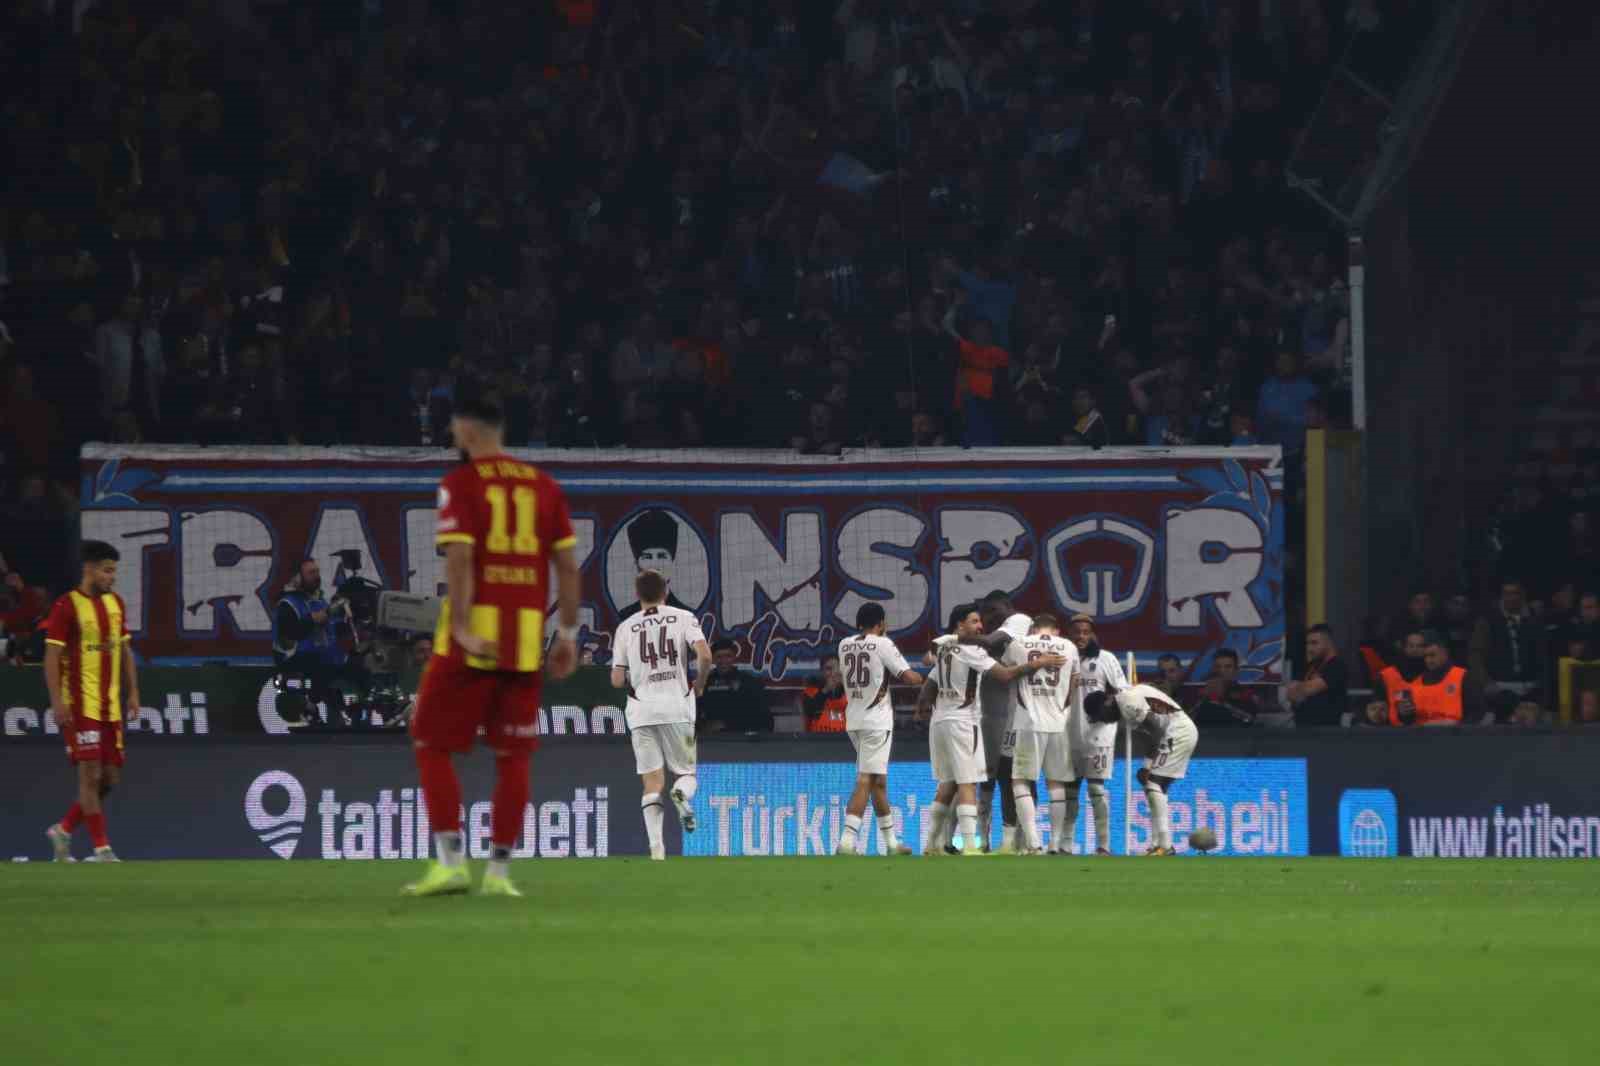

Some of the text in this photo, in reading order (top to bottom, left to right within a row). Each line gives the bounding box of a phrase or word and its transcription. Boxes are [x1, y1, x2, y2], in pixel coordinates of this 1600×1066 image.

[483, 484, 539, 556] 11
[80, 505, 1264, 634] TRAONSPOR
[631, 615, 677, 633] onvo
[639, 625, 678, 670] 44
[841, 642, 877, 653] onvo
[844, 651, 871, 689] 26
[318, 787, 608, 860] tatileeti
